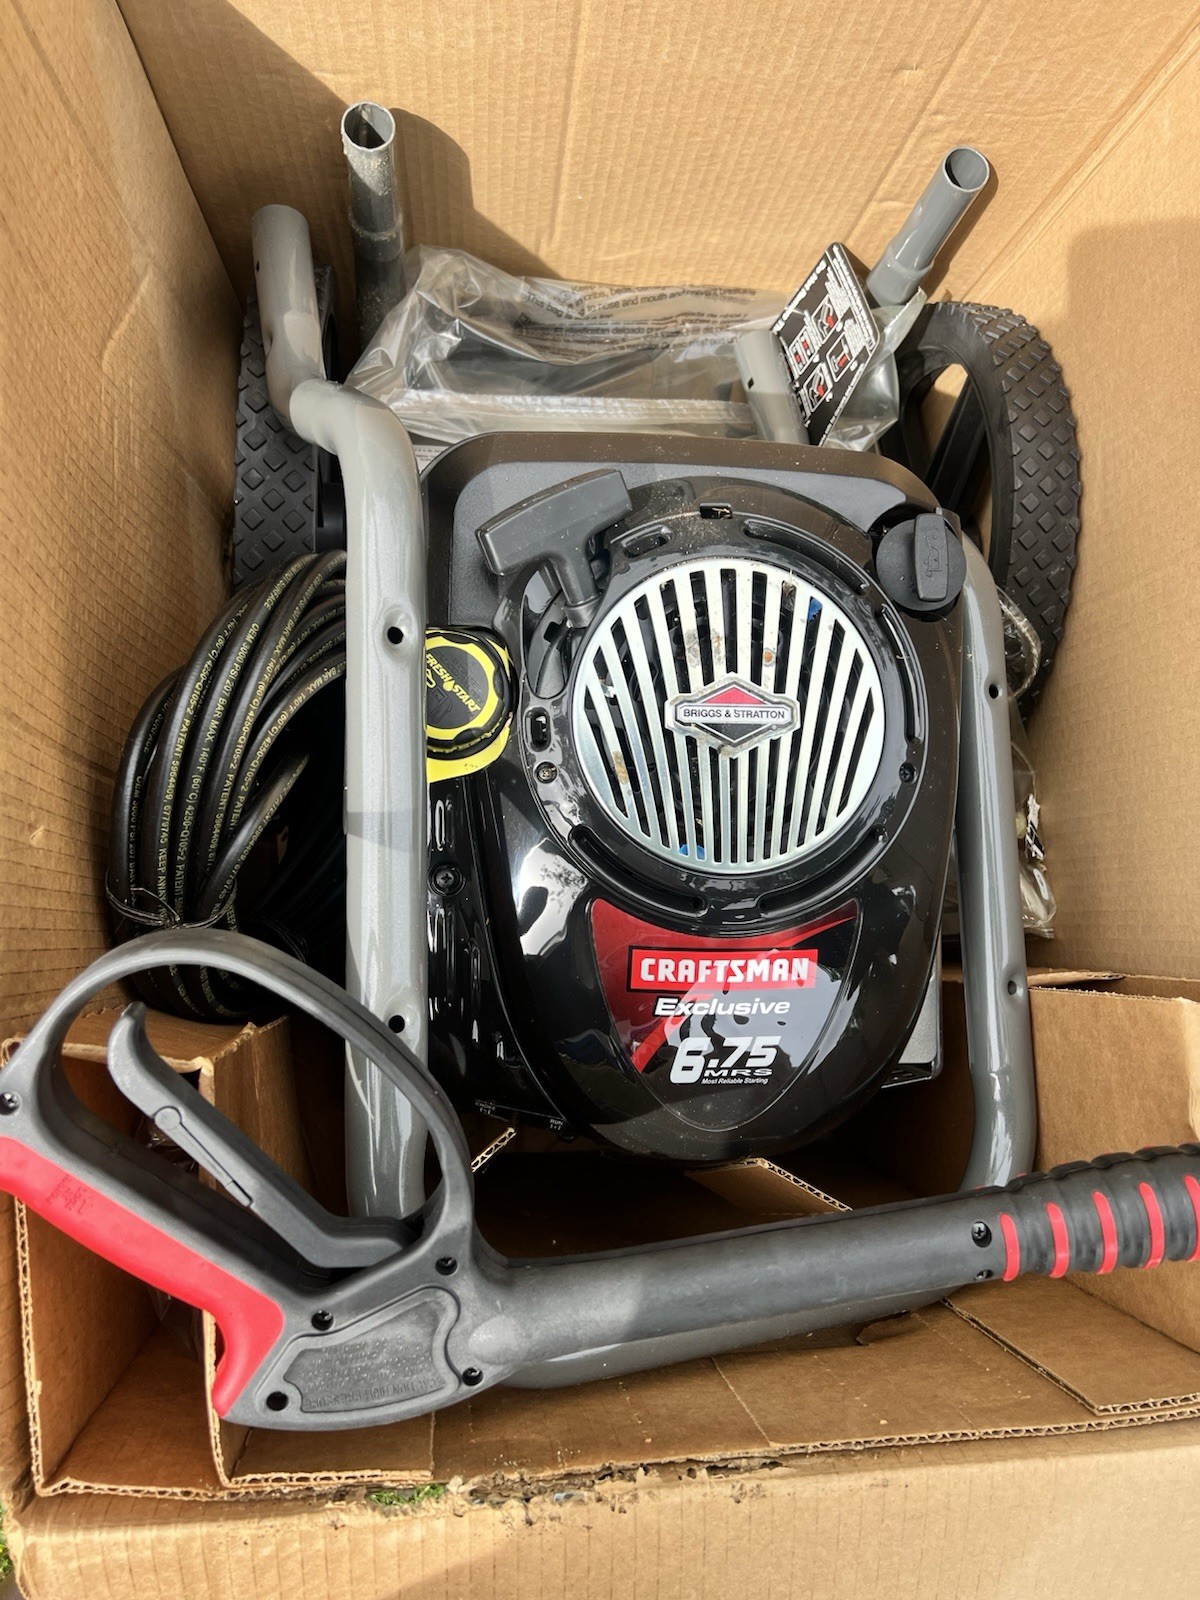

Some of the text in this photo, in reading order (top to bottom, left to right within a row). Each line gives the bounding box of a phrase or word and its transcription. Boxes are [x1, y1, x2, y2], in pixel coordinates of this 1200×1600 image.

[621, 295, 639, 308] and
[262, 579, 287, 611] SURFACE
[245, 622, 261, 643] OEM
[282, 618, 296, 636] BAR
[235, 641, 251, 664] 3000
[228, 662, 242, 679] PSI
[321, 666, 338, 681] BAR
[426, 653, 453, 682] FRESH
[453, 684, 481, 713] START
[184, 658, 215, 715] 4250-Q105-2
[221, 679, 235, 696] 207
[304, 675, 325, 694] MAX.
[212, 696, 228, 718] BAR
[683, 708, 785, 719] BRIGGS & STRATTON
[173, 717, 191, 757] PATENT
[203, 718, 219, 744] MAX.
[229, 708, 255, 770] 4250-Q105-2
[238, 734, 273, 791] 4250-Q105-2
[132, 773, 143, 798] OEM
[163, 758, 179, 803] 5964409,
[217, 772, 234, 811] PATENT
[159, 803, 171, 843] 6779745
[176, 804, 194, 861] 4250-Q105-2
[156, 846, 167, 872] KEEP
[174, 863, 184, 896] PATENT
[640, 957, 810, 983] CRAFTSMAN
[654, 997, 791, 1016] Exclusive
[670, 1035, 782, 1084] 6.75
[704, 1068, 773, 1077] MRS
[718, 1077, 743, 1085] Reliable
[744, 1077, 769, 1085] Starting
